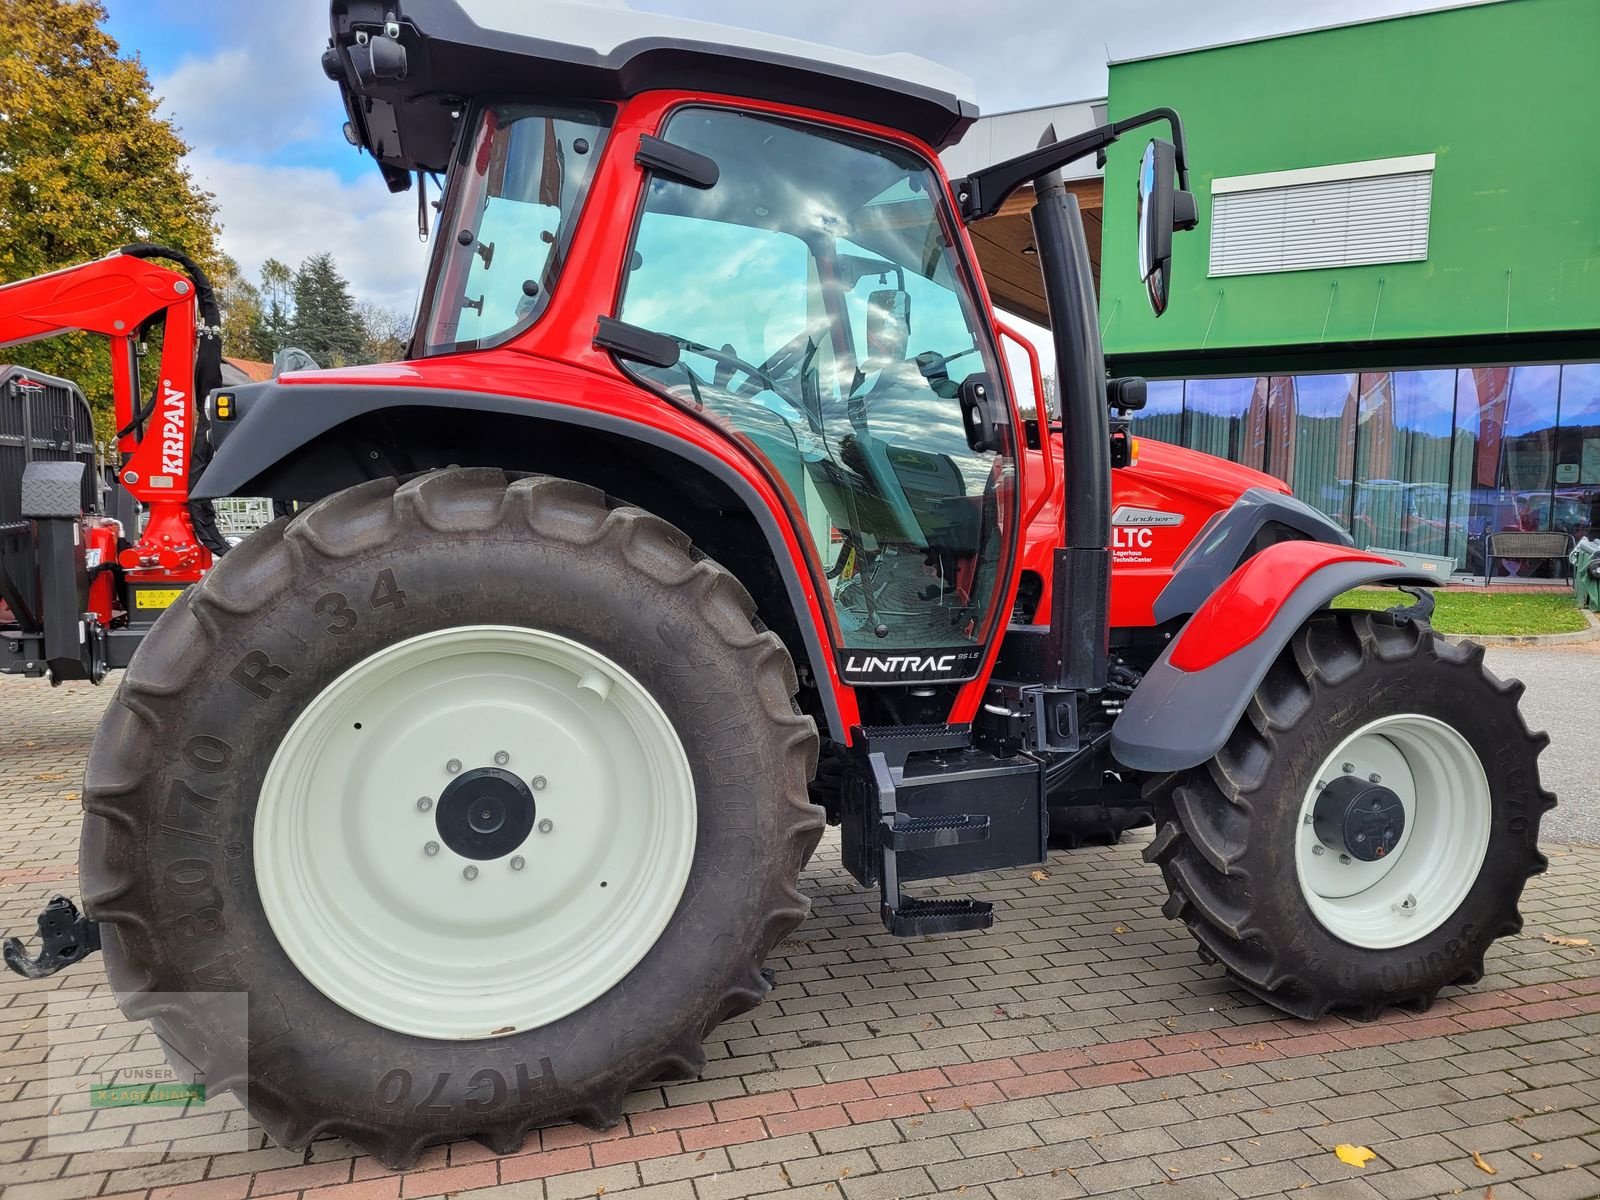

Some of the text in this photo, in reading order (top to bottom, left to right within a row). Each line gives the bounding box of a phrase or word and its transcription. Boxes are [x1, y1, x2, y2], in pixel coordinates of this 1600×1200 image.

[162, 387, 186, 476] KRPAN
[1125, 514, 1174, 523] Lindner
[1112, 528, 1153, 548] LTC
[226, 648, 294, 702] R
[312, 567, 407, 637] 34
[845, 655, 956, 672] LINTRAC
